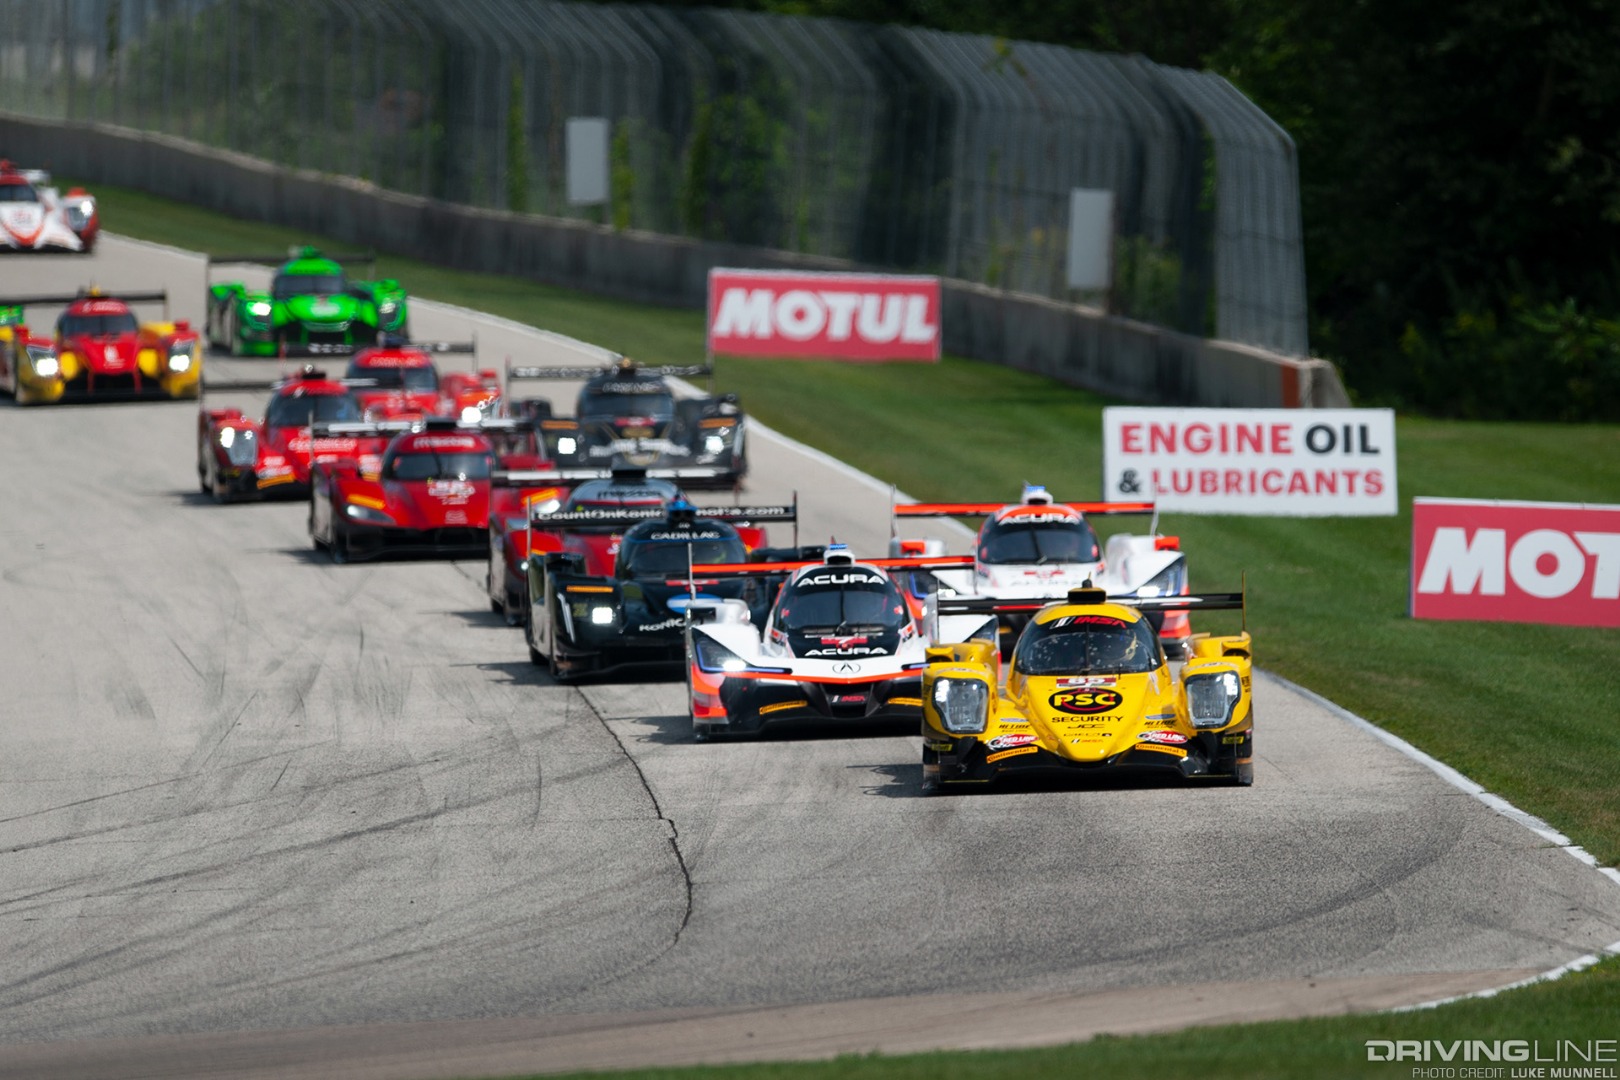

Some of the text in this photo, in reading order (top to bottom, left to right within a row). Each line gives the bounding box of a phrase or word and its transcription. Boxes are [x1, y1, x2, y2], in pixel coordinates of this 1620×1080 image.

[713, 288, 937, 343] MOTUL
[1120, 424, 1380, 454] ENGINE OIL
[1118, 468, 1384, 495] & LUBRICANTS
[998, 513, 1081, 526] ACURA
[651, 532, 721, 540] CADILLAC
[797, 573, 885, 588] ACURA
[639, 618, 688, 632] KONIC
[1073, 616, 1127, 629] IMSA
[804, 647, 889, 657] ACURA
[1053, 693, 1117, 707] PSC
